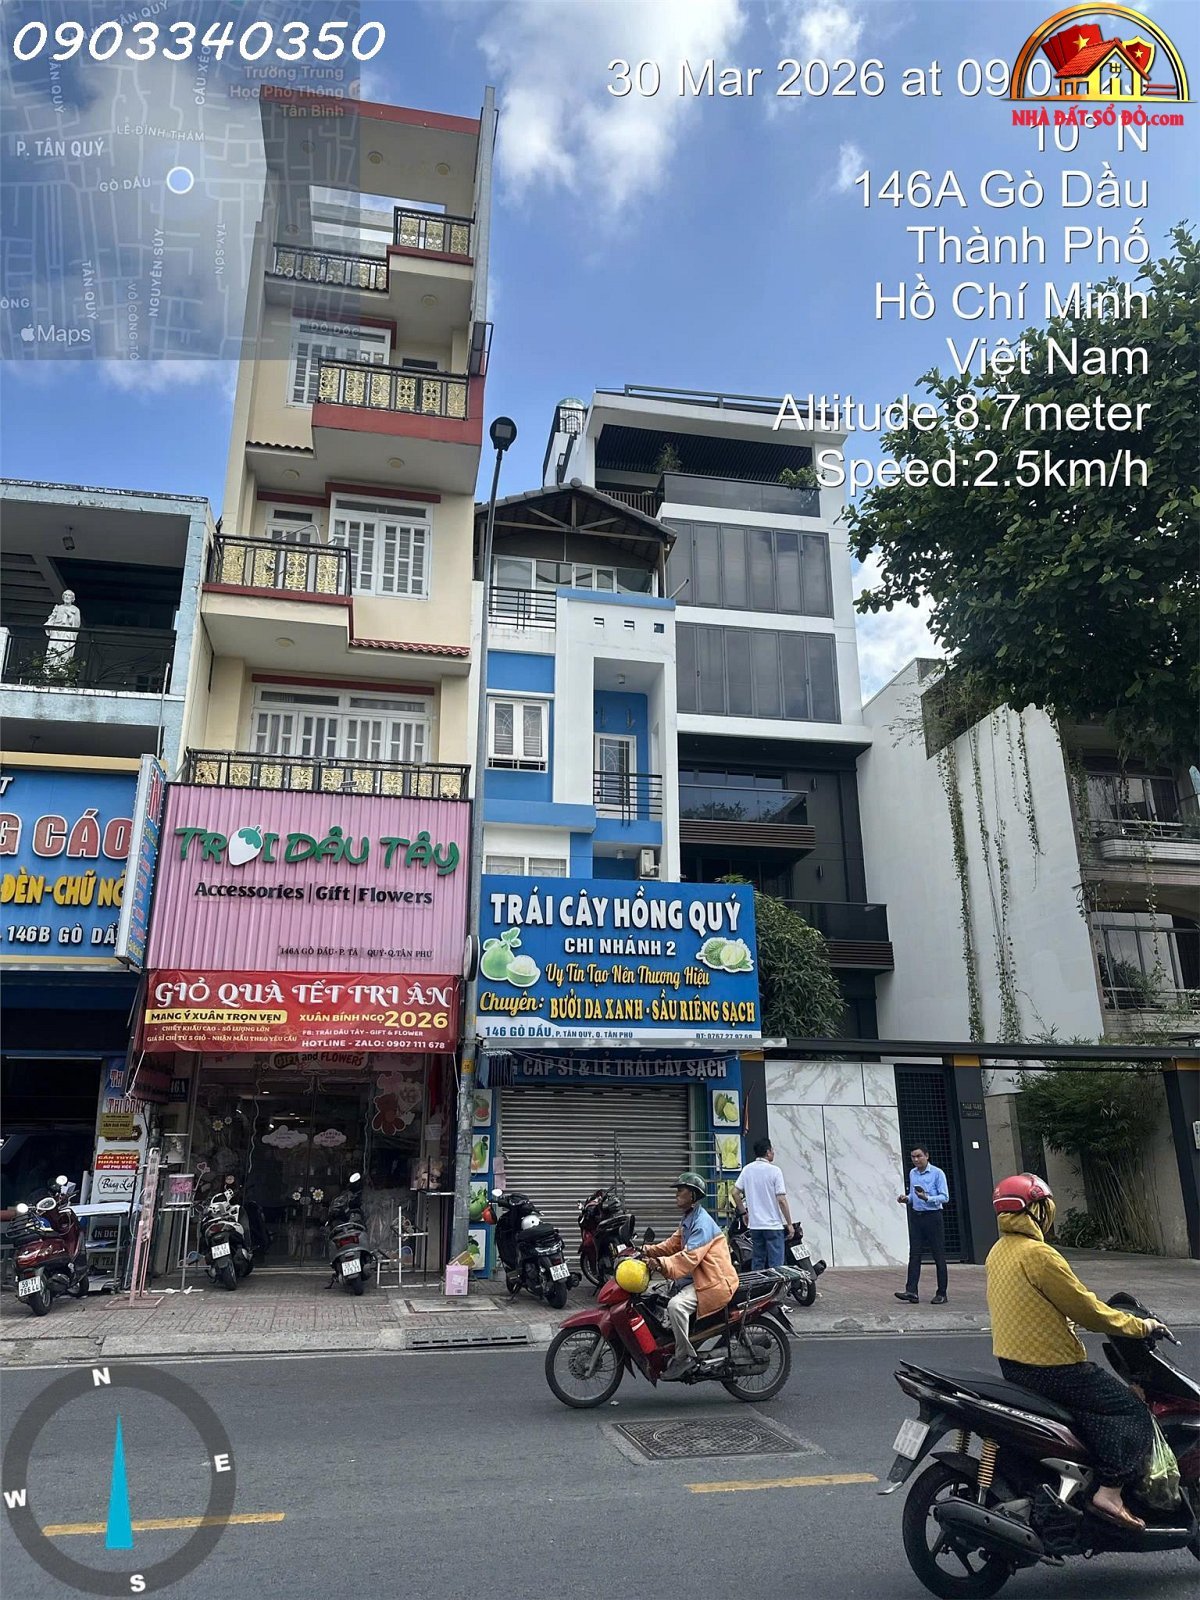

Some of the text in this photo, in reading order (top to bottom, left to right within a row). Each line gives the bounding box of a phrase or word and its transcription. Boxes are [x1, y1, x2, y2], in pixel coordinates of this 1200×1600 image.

[33, 808, 134, 860] CÁO
[284, 826, 370, 865] DÂU
[379, 830, 460, 877] TÂY
[194, 882, 432, 904] Accessories Gift Flowers
[490, 885, 741, 938] TRÁI CÂY HỒNG QUÝ
[8, 923, 118, 944] 146B GÒ DẦ
[564, 934, 676, 956] CHI NHÁNH 2
[545, 963, 711, 990] Uy Tín Tạo Nên Thương Hiệu
[155, 977, 453, 1008] GIỎ QUÀ TẾT TRI ÂN
[151, 1009, 281, 1023] MANG Ý XUÂN TRỌN VẸN
[300, 1012, 331, 1022] XUÂN
[361, 1014, 385, 1024] NGỌ
[384, 1010, 449, 1028] 2026
[480, 988, 755, 1028] Chuyên: BƯỞI DA XANH SẦU RIÊNG SẠCH
[485, 1026, 506, 1037] 146
[563, 1030, 577, 1038] TÂN
[604, 1030, 618, 1038] TÂN
[386, 1040, 411, 1048] 0907
[579, 1059, 590, 1076] &
